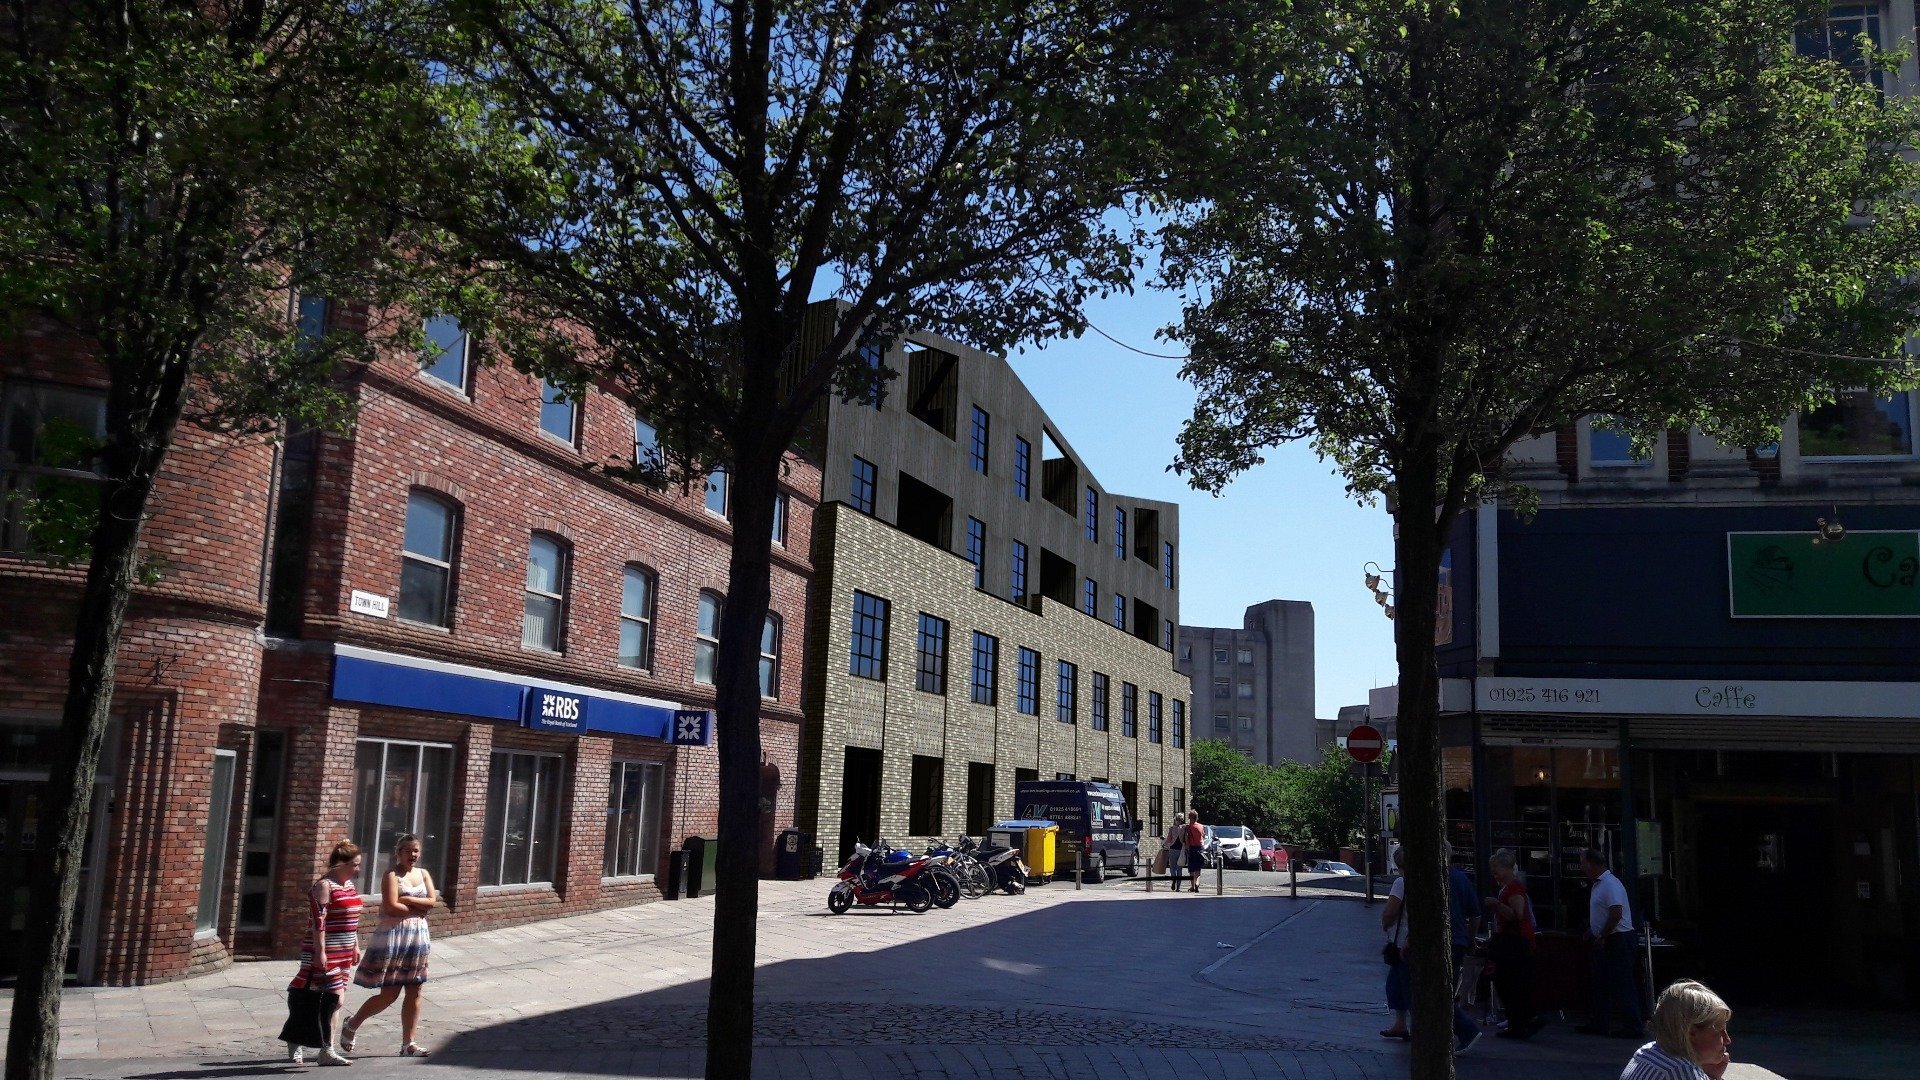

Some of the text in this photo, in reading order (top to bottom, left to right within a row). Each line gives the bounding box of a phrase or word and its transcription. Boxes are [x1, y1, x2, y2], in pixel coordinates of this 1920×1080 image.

[355, 596, 385, 612] TOWN HILL
[1489, 687, 1601, 703] 01925 416 921
[1695, 685, 1756, 709] Caffe
[555, 696, 579, 720] RBS
